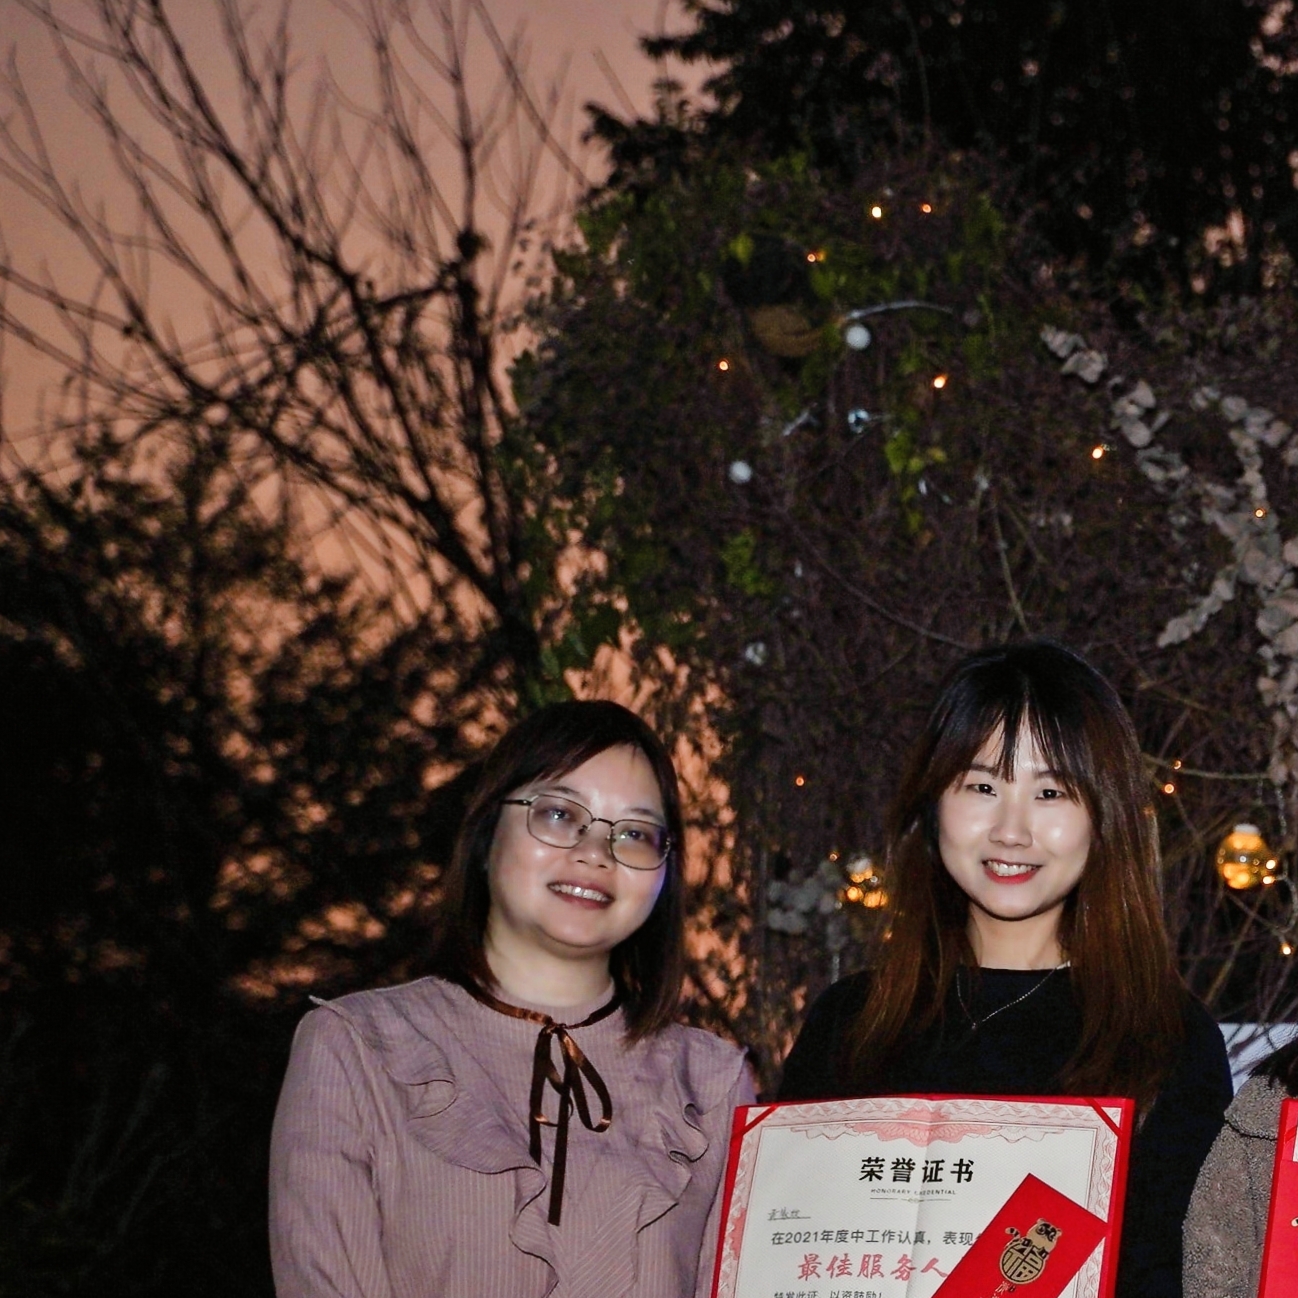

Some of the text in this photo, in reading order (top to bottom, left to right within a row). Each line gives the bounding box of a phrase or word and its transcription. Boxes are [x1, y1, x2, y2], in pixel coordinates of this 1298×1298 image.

[859, 1157, 975, 1183] 荣誉证书
[771, 1229, 983, 1246] 在2021年度中工作认真，表现
[797, 1253, 949, 1282] 最佳服务人
